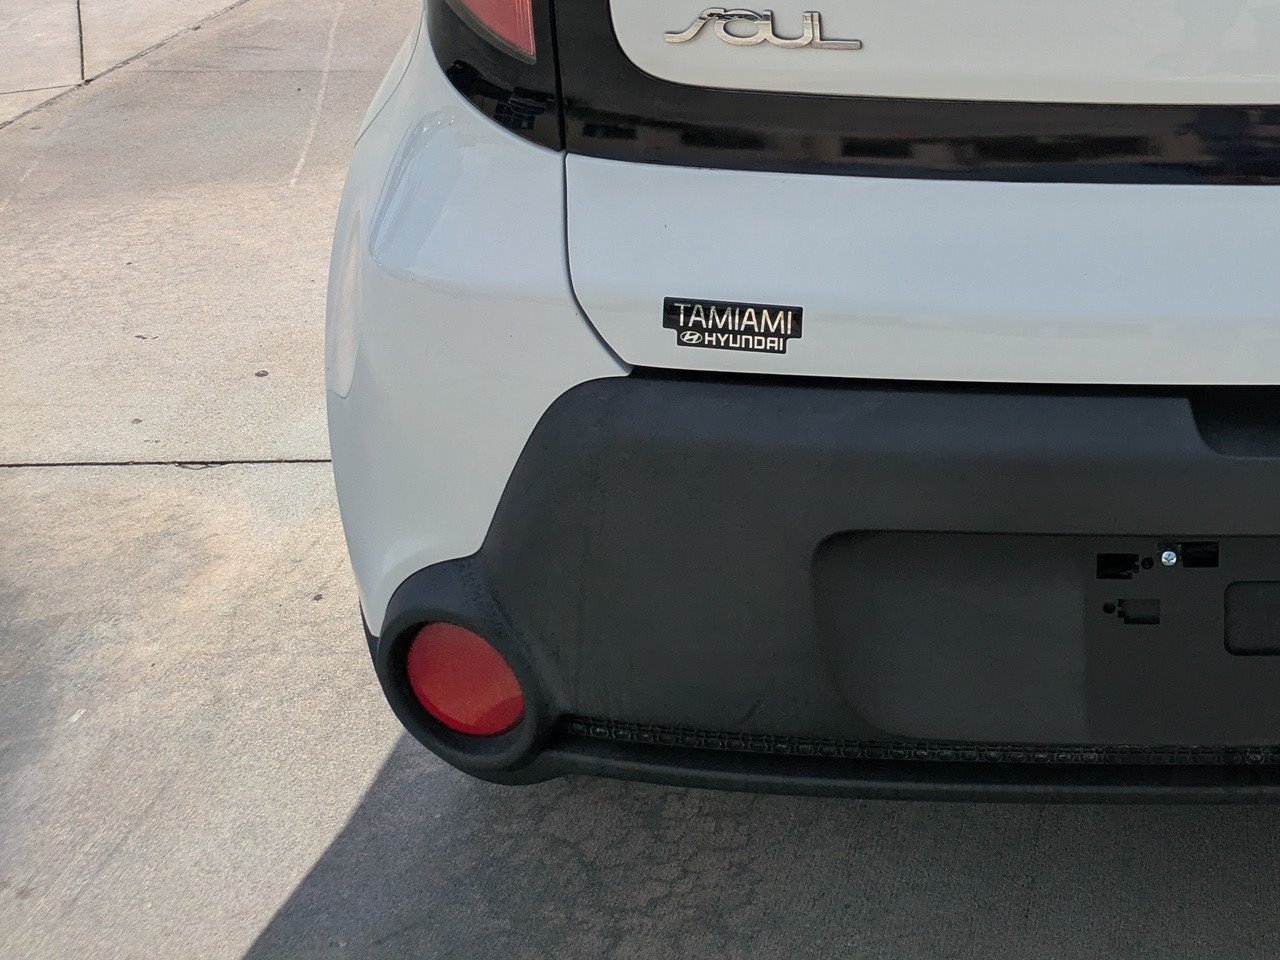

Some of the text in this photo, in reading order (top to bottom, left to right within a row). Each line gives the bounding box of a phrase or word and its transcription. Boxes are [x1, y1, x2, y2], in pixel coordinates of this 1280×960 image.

[664, 8, 862, 50] SOUL
[674, 303, 792, 335] TAMIAMI
[704, 332, 783, 351] HYUNDAI
